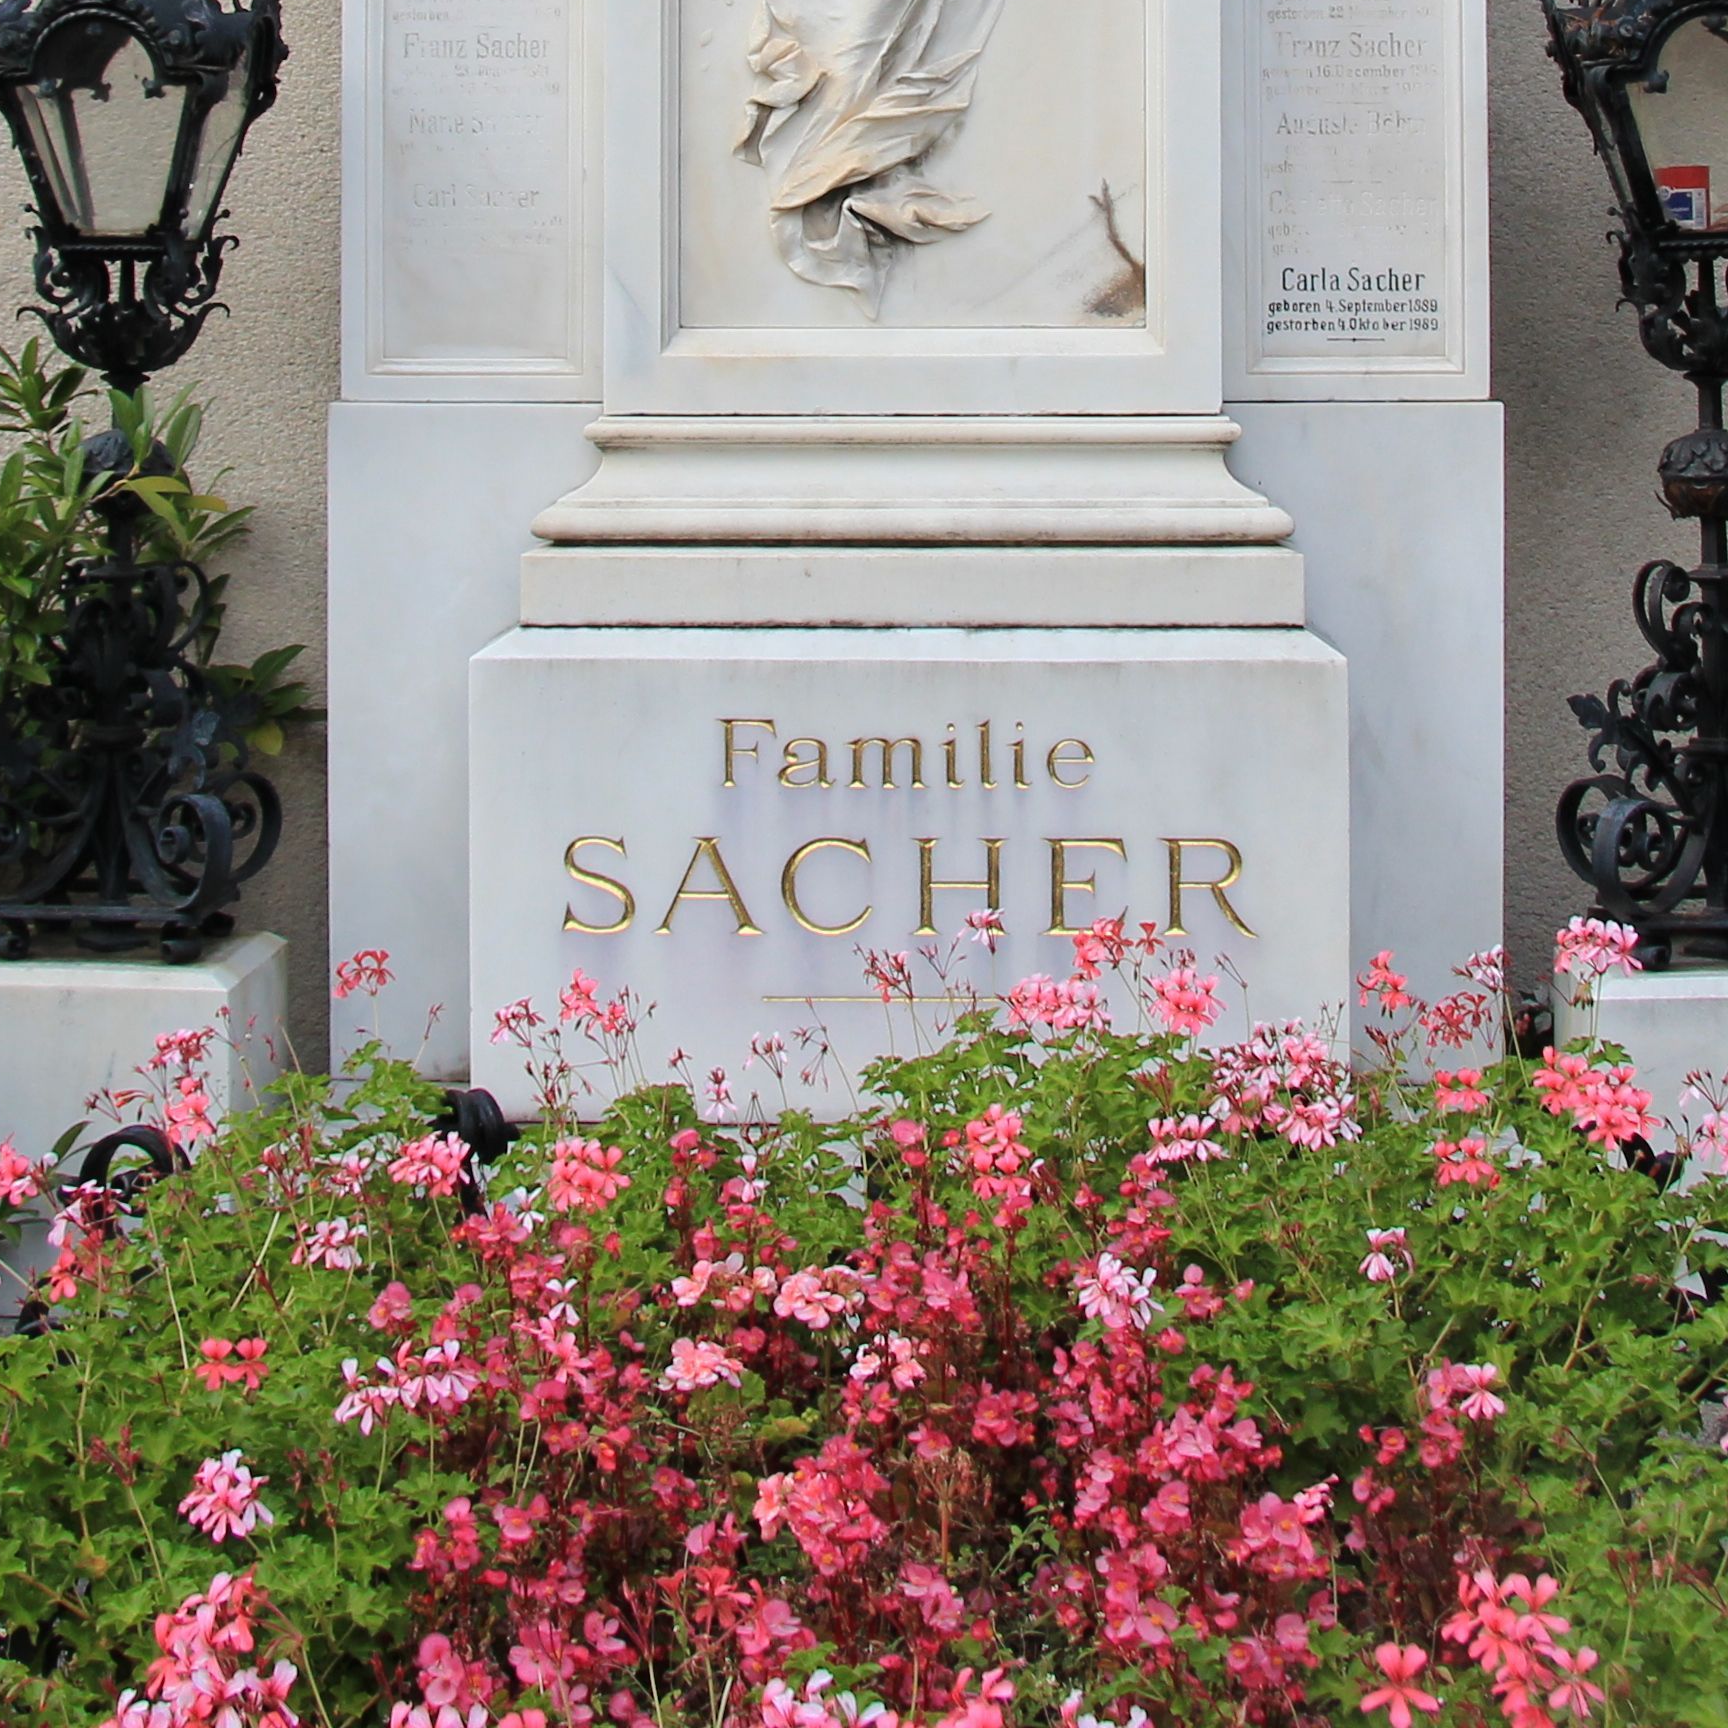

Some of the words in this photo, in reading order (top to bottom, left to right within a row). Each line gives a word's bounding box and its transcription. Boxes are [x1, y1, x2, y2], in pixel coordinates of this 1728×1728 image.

[403, 31, 468, 60] Franz
[476, 31, 551, 60] Sacher
[1274, 31, 1341, 58] Franz
[1349, 31, 1429, 58] Sacher
[413, 183, 457, 208] Carl
[1281, 267, 1341, 292] Carla
[1346, 267, 1426, 292] Sacher
[1268, 299, 1321, 317] geboren
[1338, 298, 1407, 316] September
[1266, 318, 1335, 335] gestorben
[716, 718, 1095, 791] Familie
[561, 835, 1258, 939] SACHER
